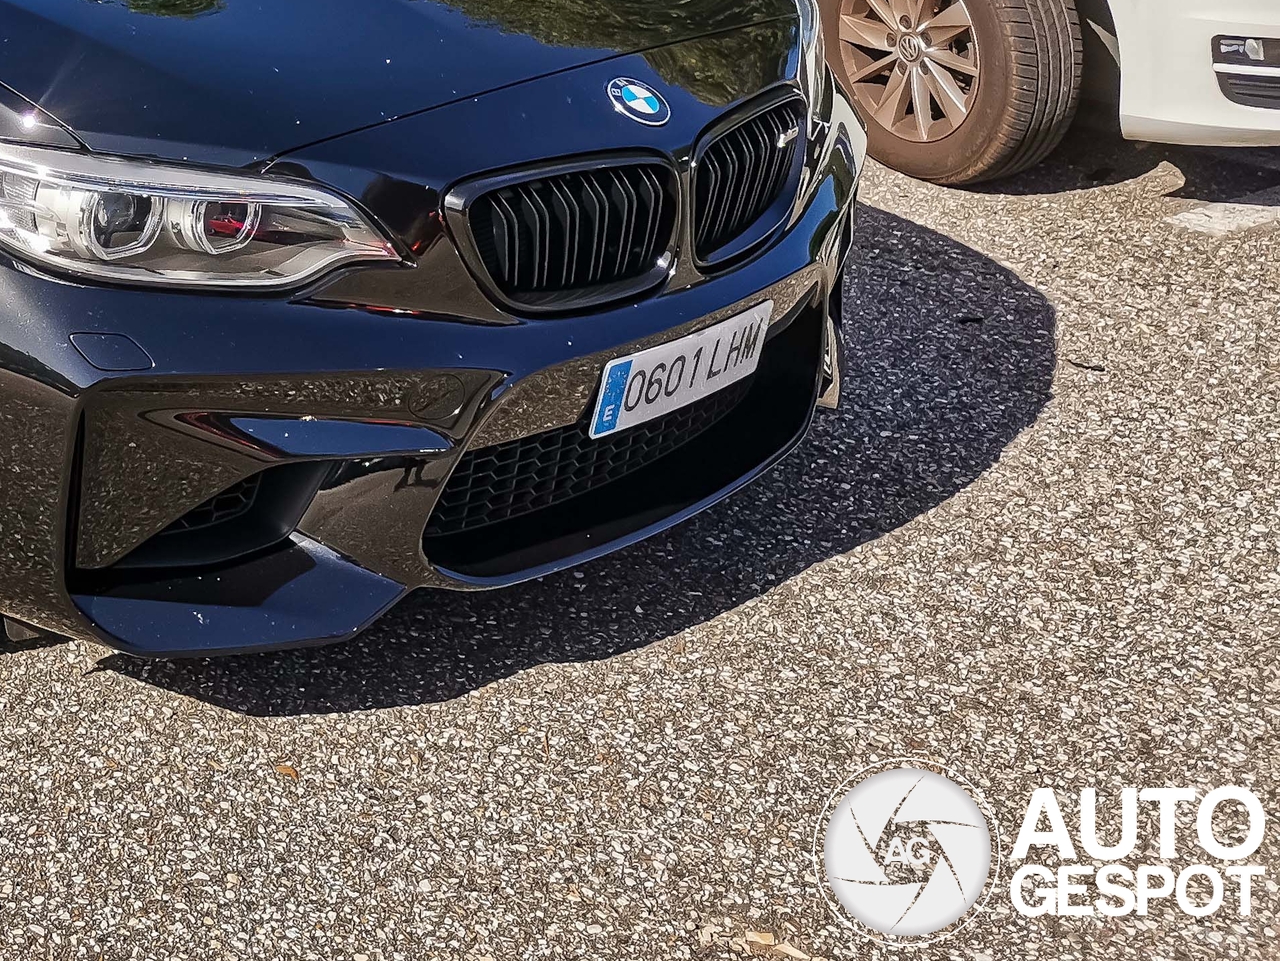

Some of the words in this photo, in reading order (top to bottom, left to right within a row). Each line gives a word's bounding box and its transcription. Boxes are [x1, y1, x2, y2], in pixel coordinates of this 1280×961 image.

[603, 405, 615, 422] E
[624, 347, 704, 412] 0601
[707, 318, 765, 381] LHM
